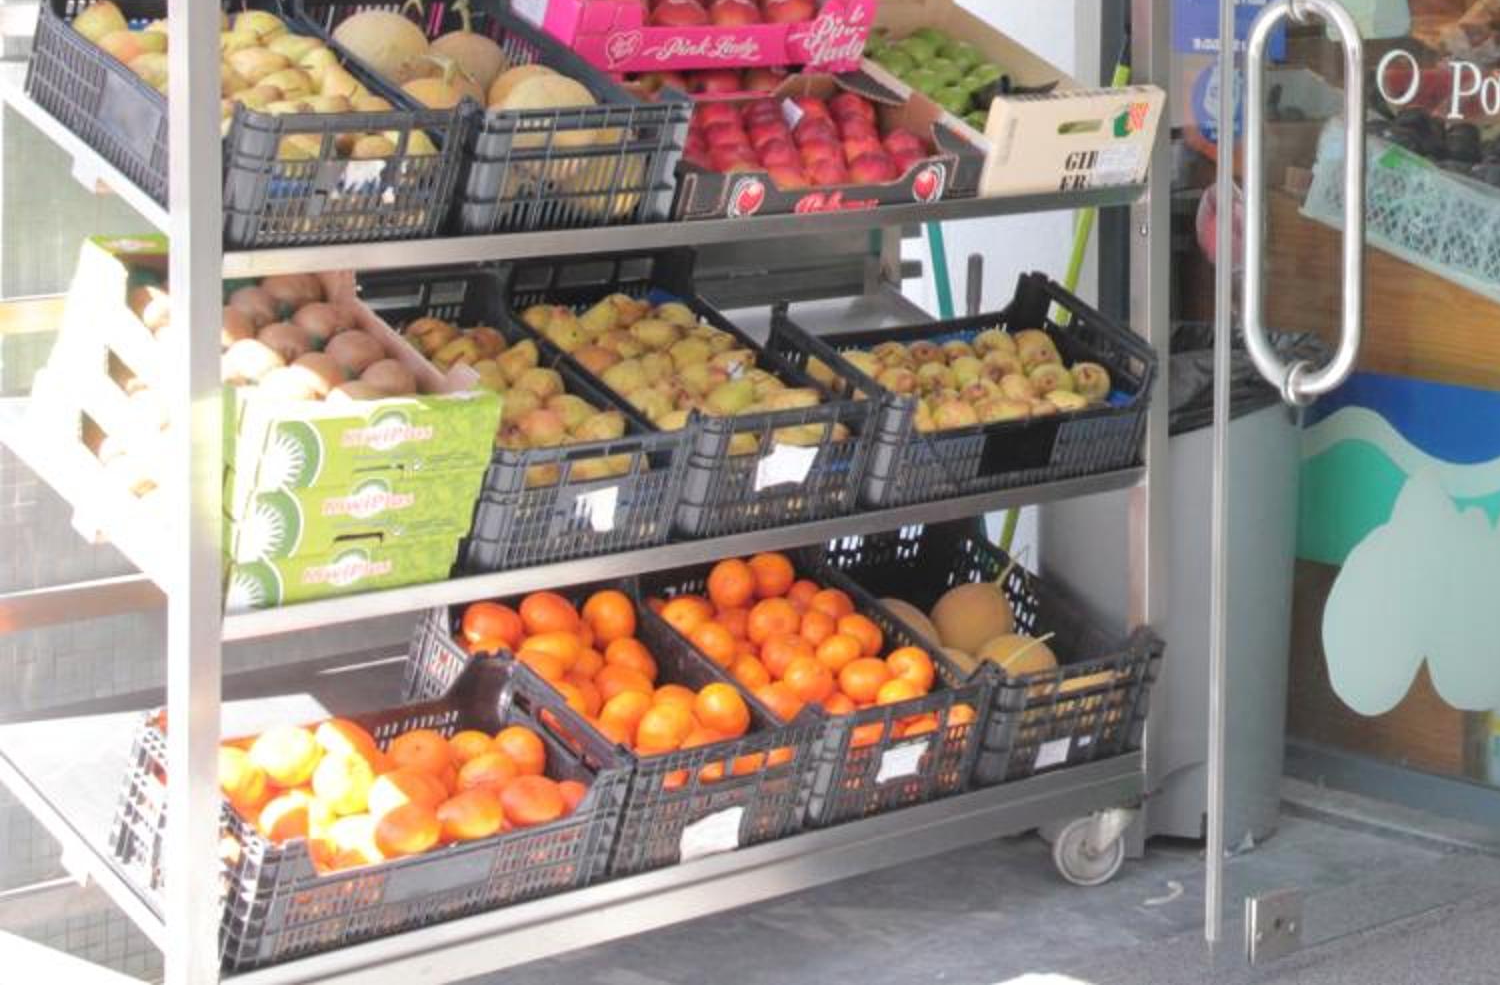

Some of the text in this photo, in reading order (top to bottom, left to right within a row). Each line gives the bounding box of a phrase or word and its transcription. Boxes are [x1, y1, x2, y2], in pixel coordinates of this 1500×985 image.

[643, 35, 761, 61] Pink Lady
[1376, 48, 1420, 105] O
